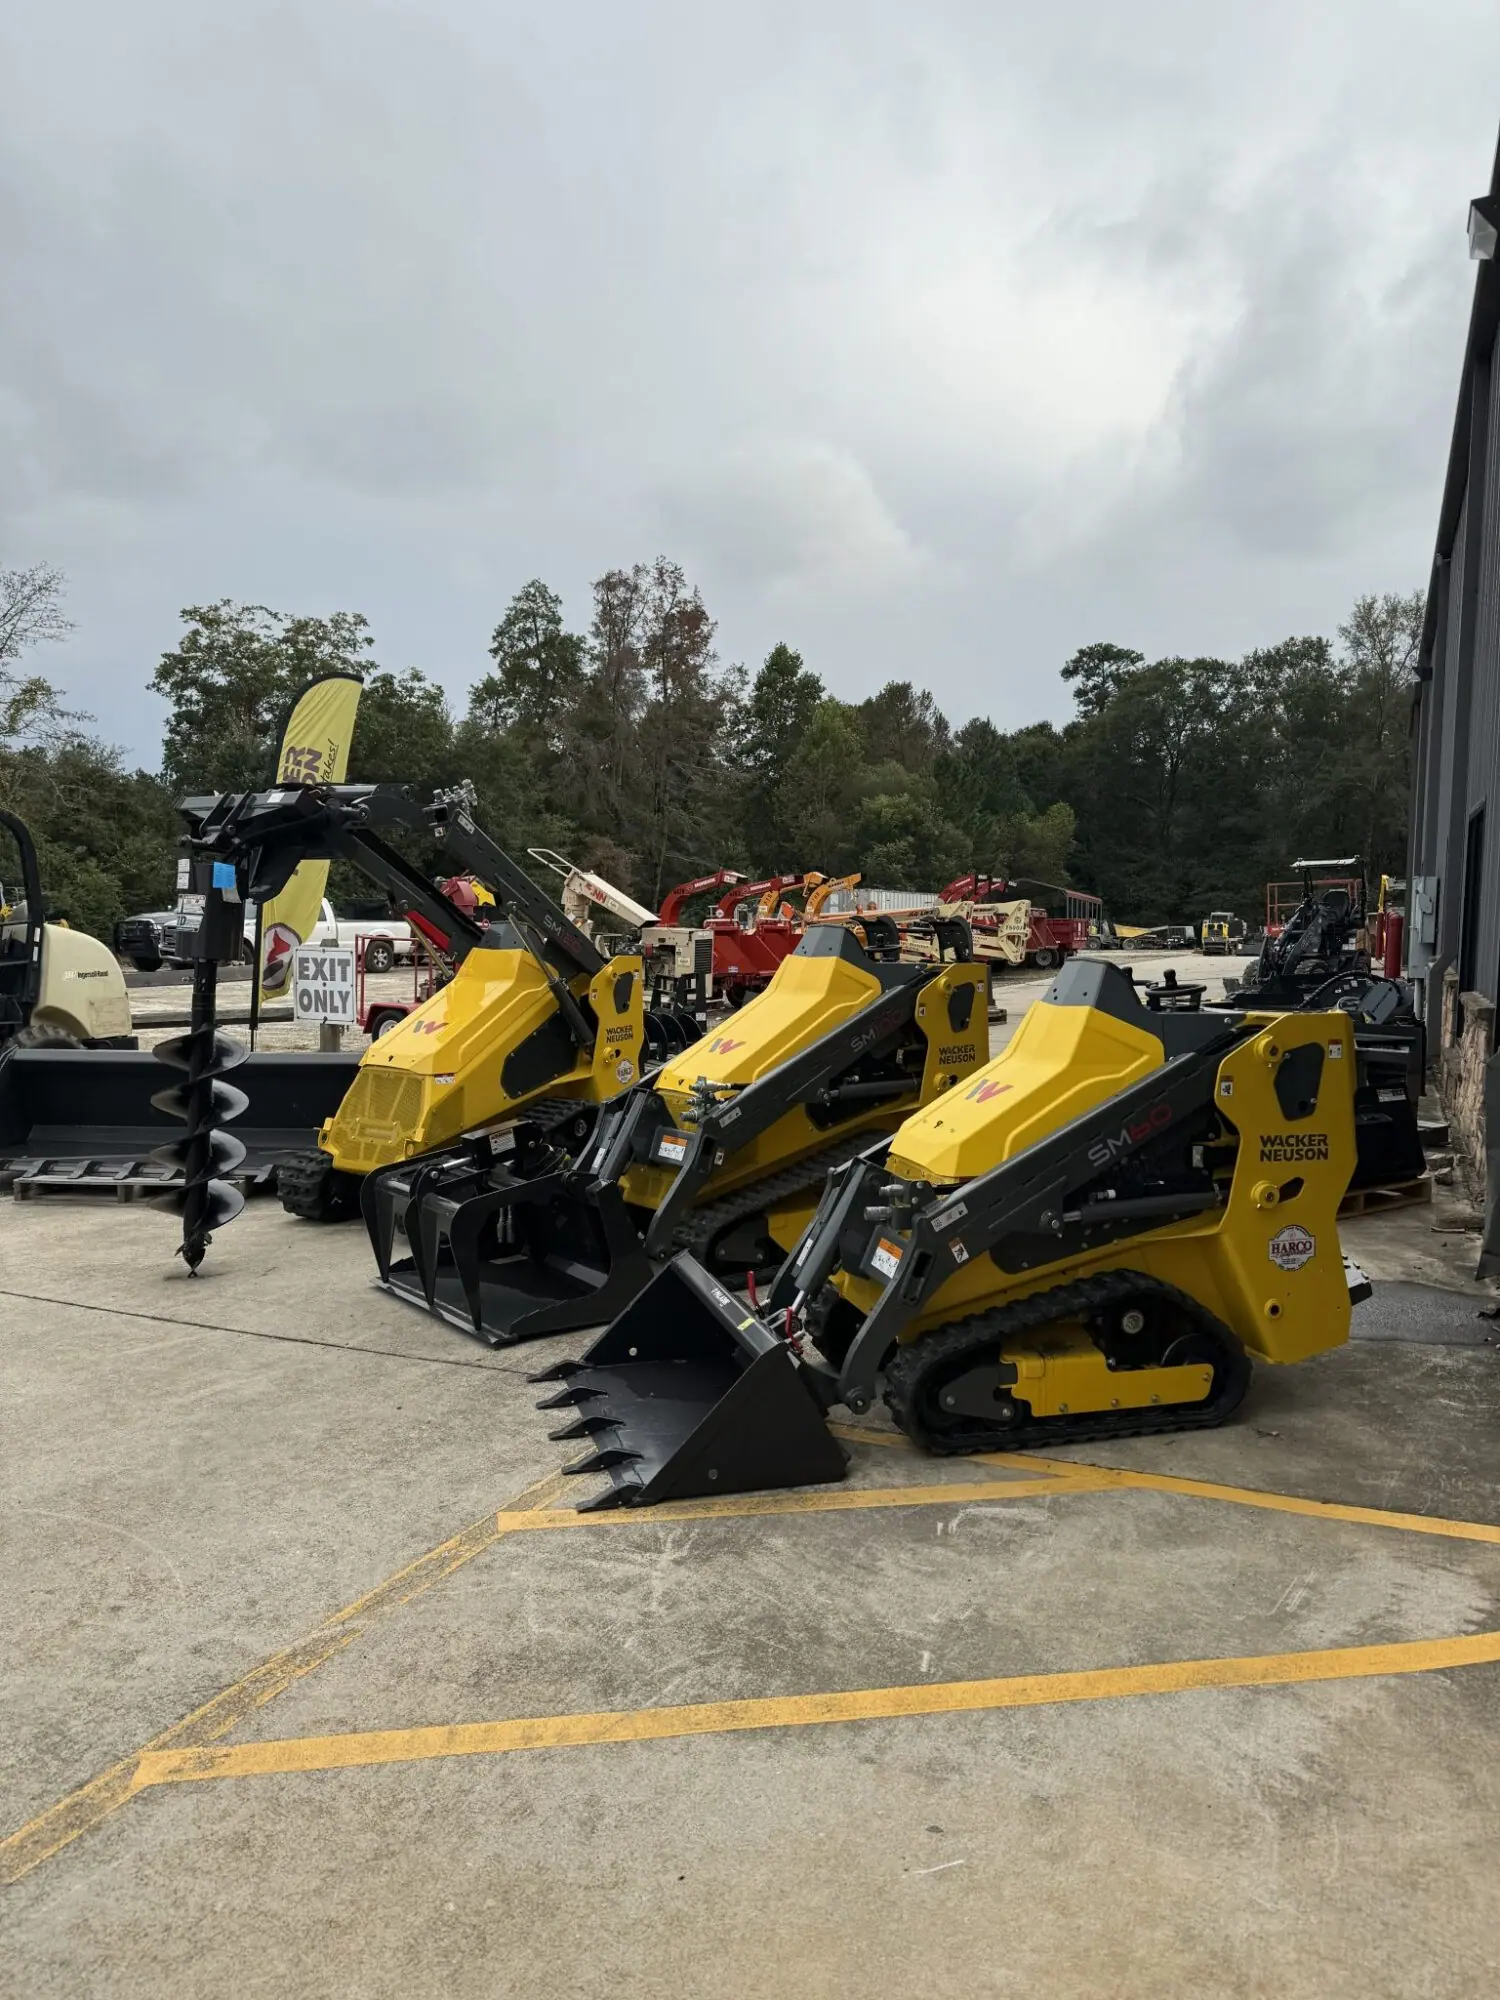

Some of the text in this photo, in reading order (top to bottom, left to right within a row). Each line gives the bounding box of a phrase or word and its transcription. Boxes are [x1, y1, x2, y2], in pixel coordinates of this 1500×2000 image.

[299, 957, 351, 982] EXIT
[299, 988, 351, 1014] ONLY
[939, 1044, 976, 1055] WACKER
[939, 1053, 976, 1065] NEUSON
[1087, 1103, 1173, 1167] SM60
[1260, 1133, 1329, 1148] WACKER
[1260, 1147, 1329, 1162] NEUSON
[1271, 1240, 1313, 1255] HARCO
